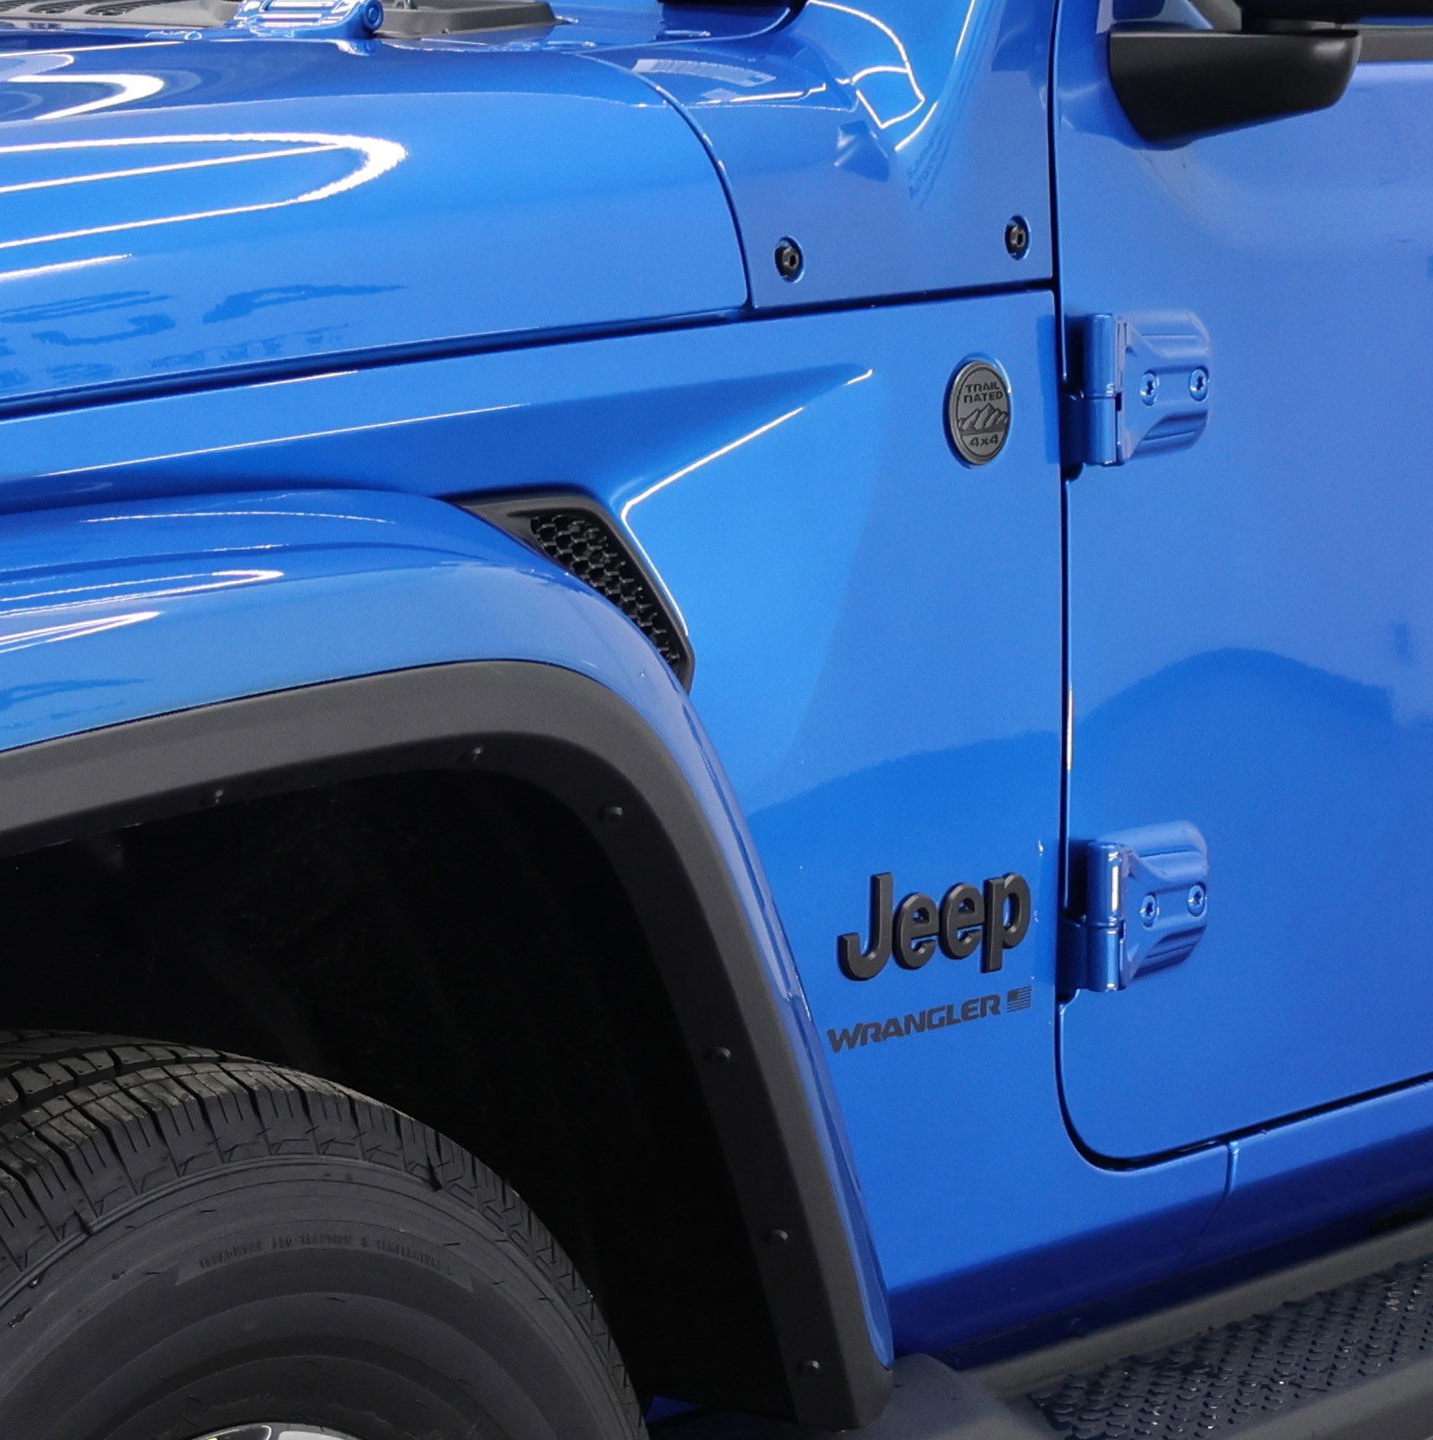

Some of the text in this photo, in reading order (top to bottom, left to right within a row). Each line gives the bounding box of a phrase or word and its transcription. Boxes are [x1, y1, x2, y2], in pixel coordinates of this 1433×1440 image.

[965, 383, 1000, 393] TRAIL
[964, 391, 1004, 403] RATED
[970, 434, 999, 447] 4x4
[837, 871, 1031, 982] Jeep
[827, 994, 1002, 1054] WRANGLER
